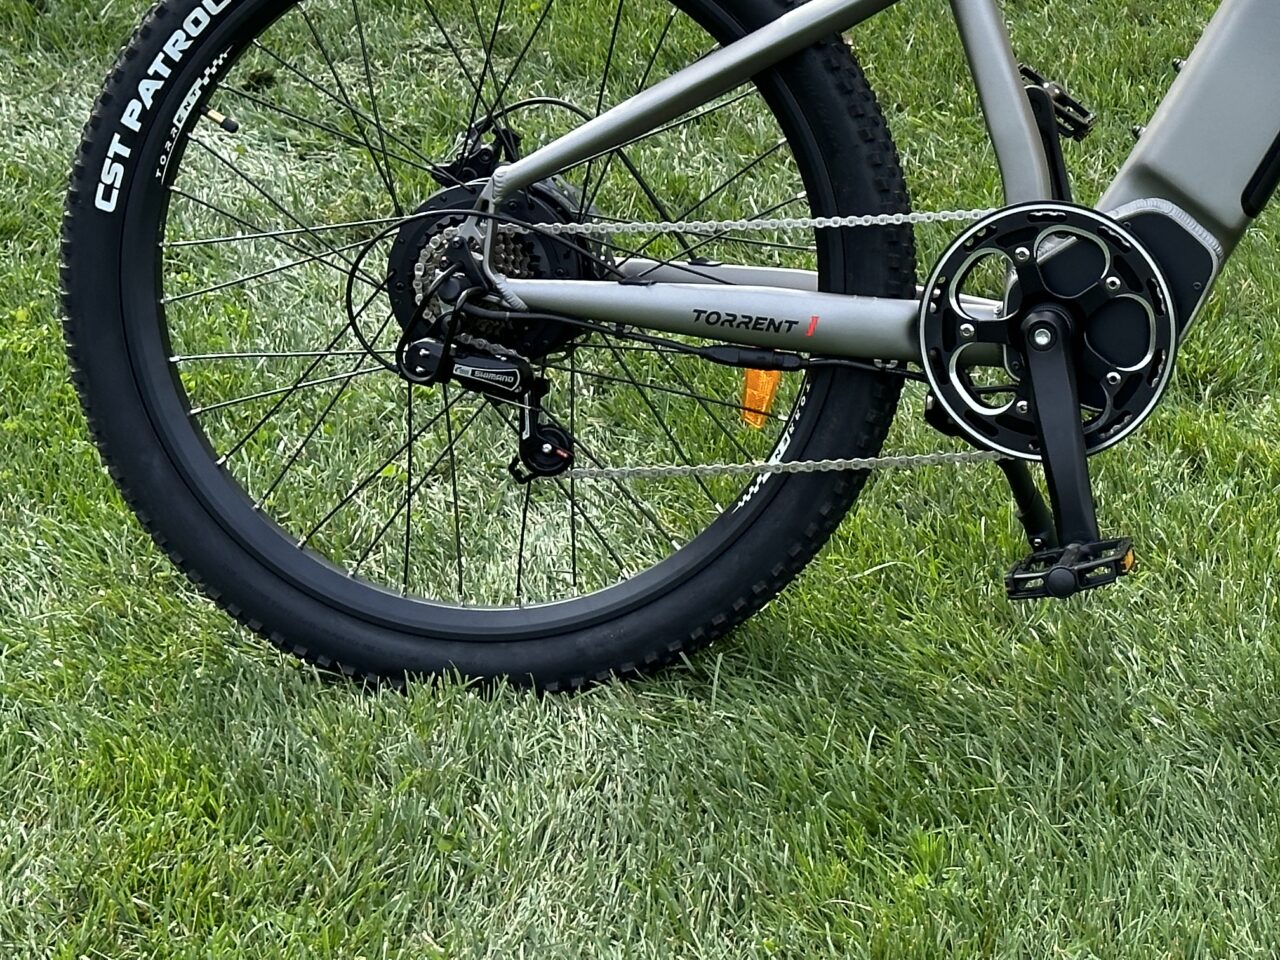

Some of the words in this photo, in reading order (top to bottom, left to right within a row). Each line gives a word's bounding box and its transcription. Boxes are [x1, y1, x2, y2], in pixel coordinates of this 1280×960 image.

[94, 132, 132, 213] CST
[155, 87, 199, 178] TORRENT
[693, 308, 799, 335] TORRENT
[474, 369, 515, 384] SHIMANO
[773, 383, 812, 463] TORREN
